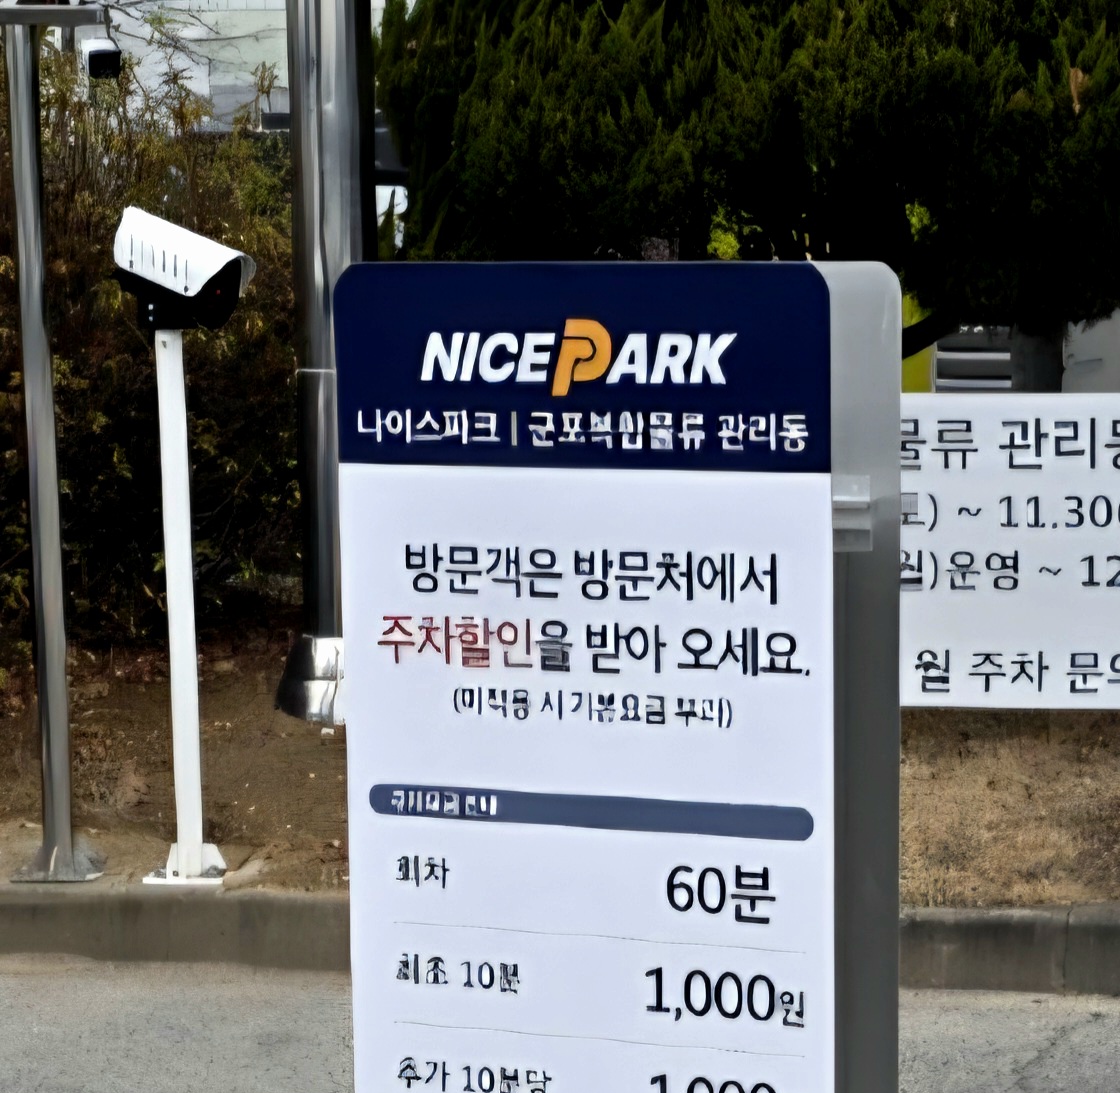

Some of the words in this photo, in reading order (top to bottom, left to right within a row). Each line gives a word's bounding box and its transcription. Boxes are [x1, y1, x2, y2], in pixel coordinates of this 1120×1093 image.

[420, 317, 738, 397] NICEPARK
[717, 412, 809, 453] 관리동
[405, 542, 564, 599] 방문객은
[573, 548, 778, 606] 방문처에서
[377, 615, 574, 673] 주차할인을
[585, 622, 668, 675] 받아
[676, 626, 811, 677] 오세요.
[968, 650, 1050, 693] 주차
[666, 864, 777, 925] 60분
